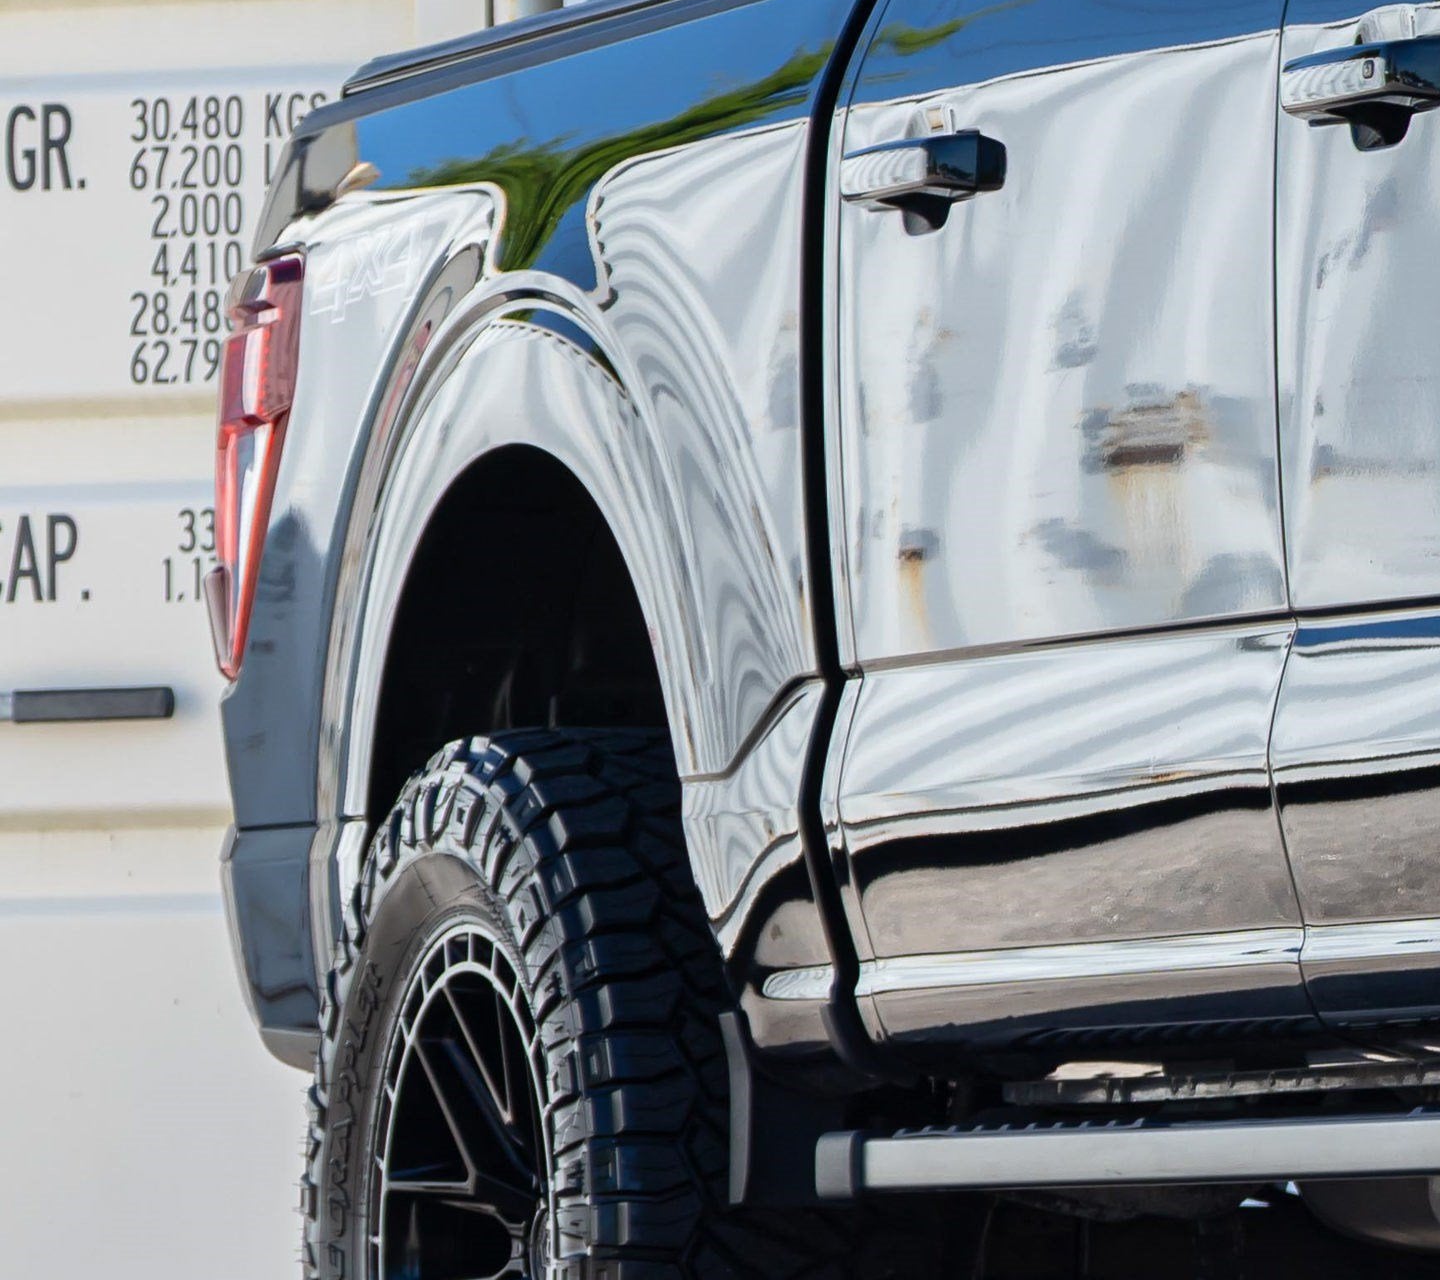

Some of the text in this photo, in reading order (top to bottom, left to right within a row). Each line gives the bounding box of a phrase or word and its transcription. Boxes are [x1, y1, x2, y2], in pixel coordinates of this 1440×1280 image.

[4, 103, 87, 192] GR.
[130, 290, 234, 336] 28,48
[131, 339, 220, 384] 62,79
[0, 513, 90, 603] AP.
[163, 556, 218, 602] 1,1
